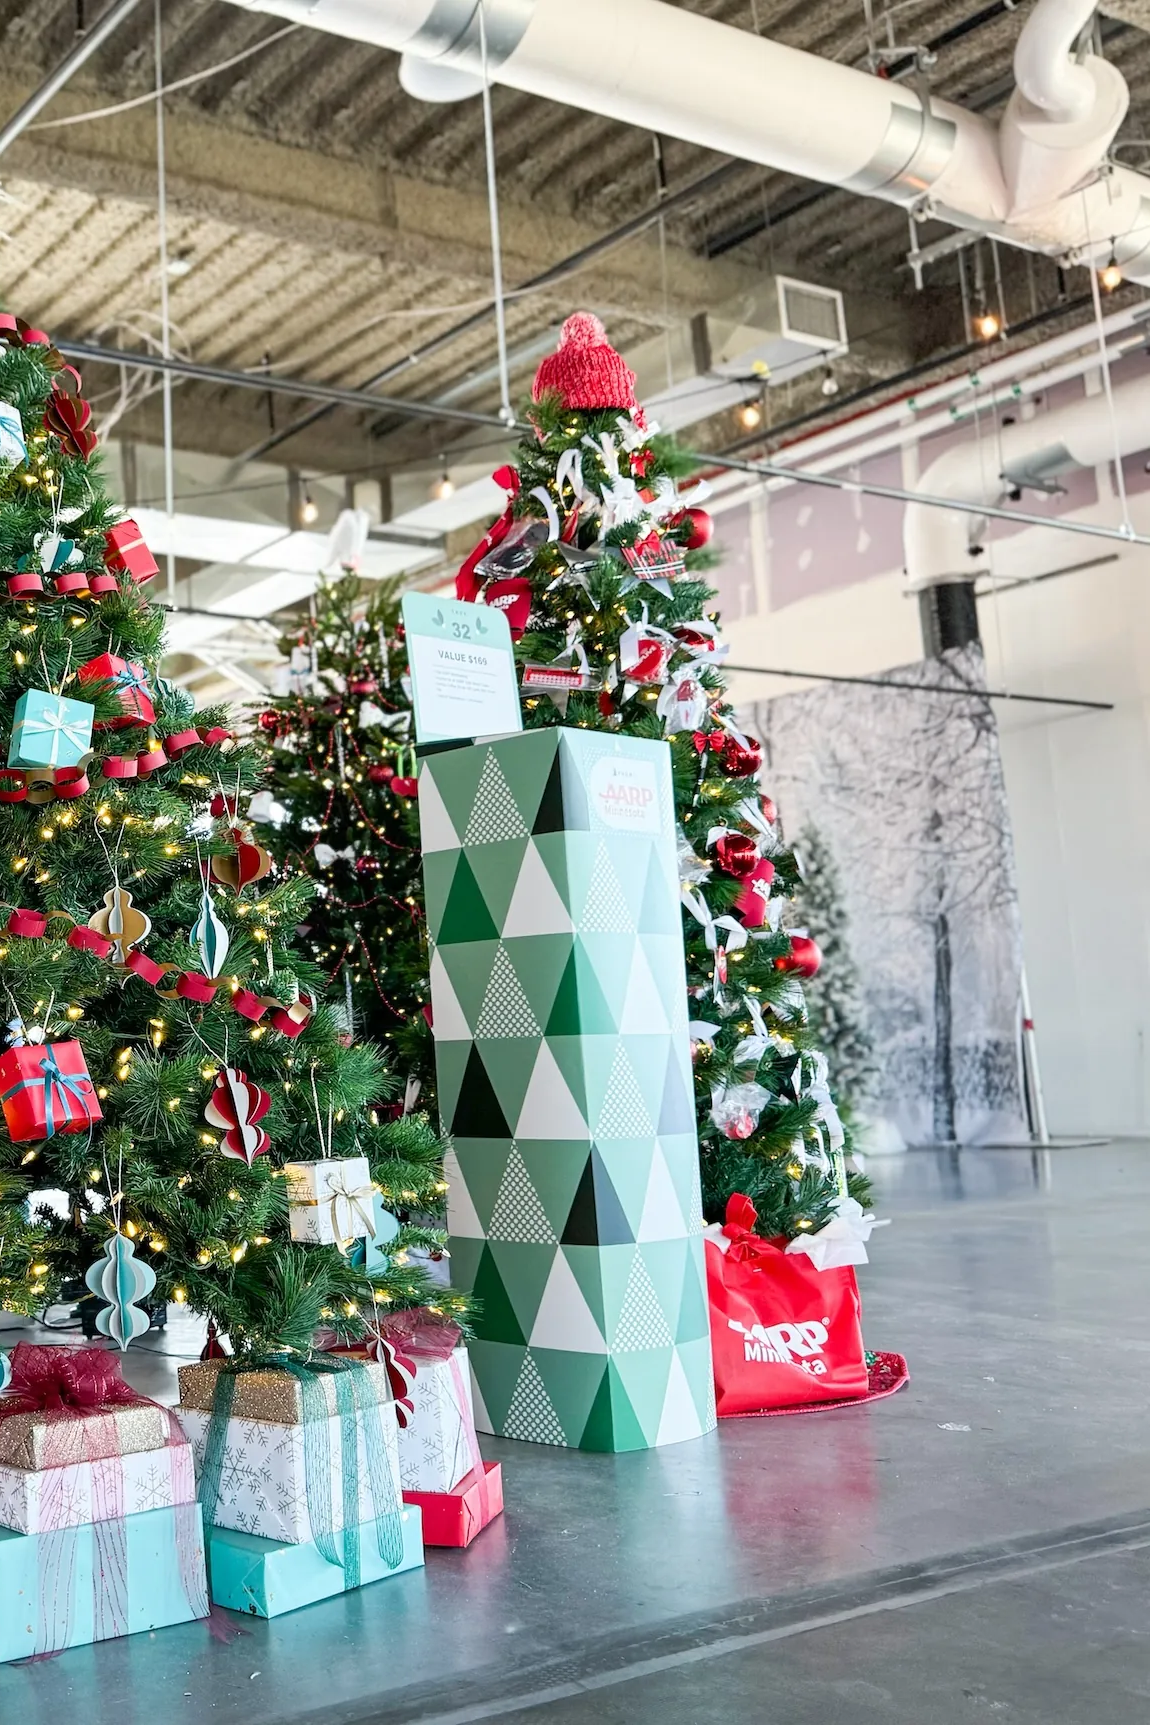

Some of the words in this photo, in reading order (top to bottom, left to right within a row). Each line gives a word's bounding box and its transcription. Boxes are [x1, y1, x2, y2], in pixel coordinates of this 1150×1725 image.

[452, 622, 471, 640] 32
[437, 649, 466, 662] VALUE
[599, 783, 653, 807] AARP
